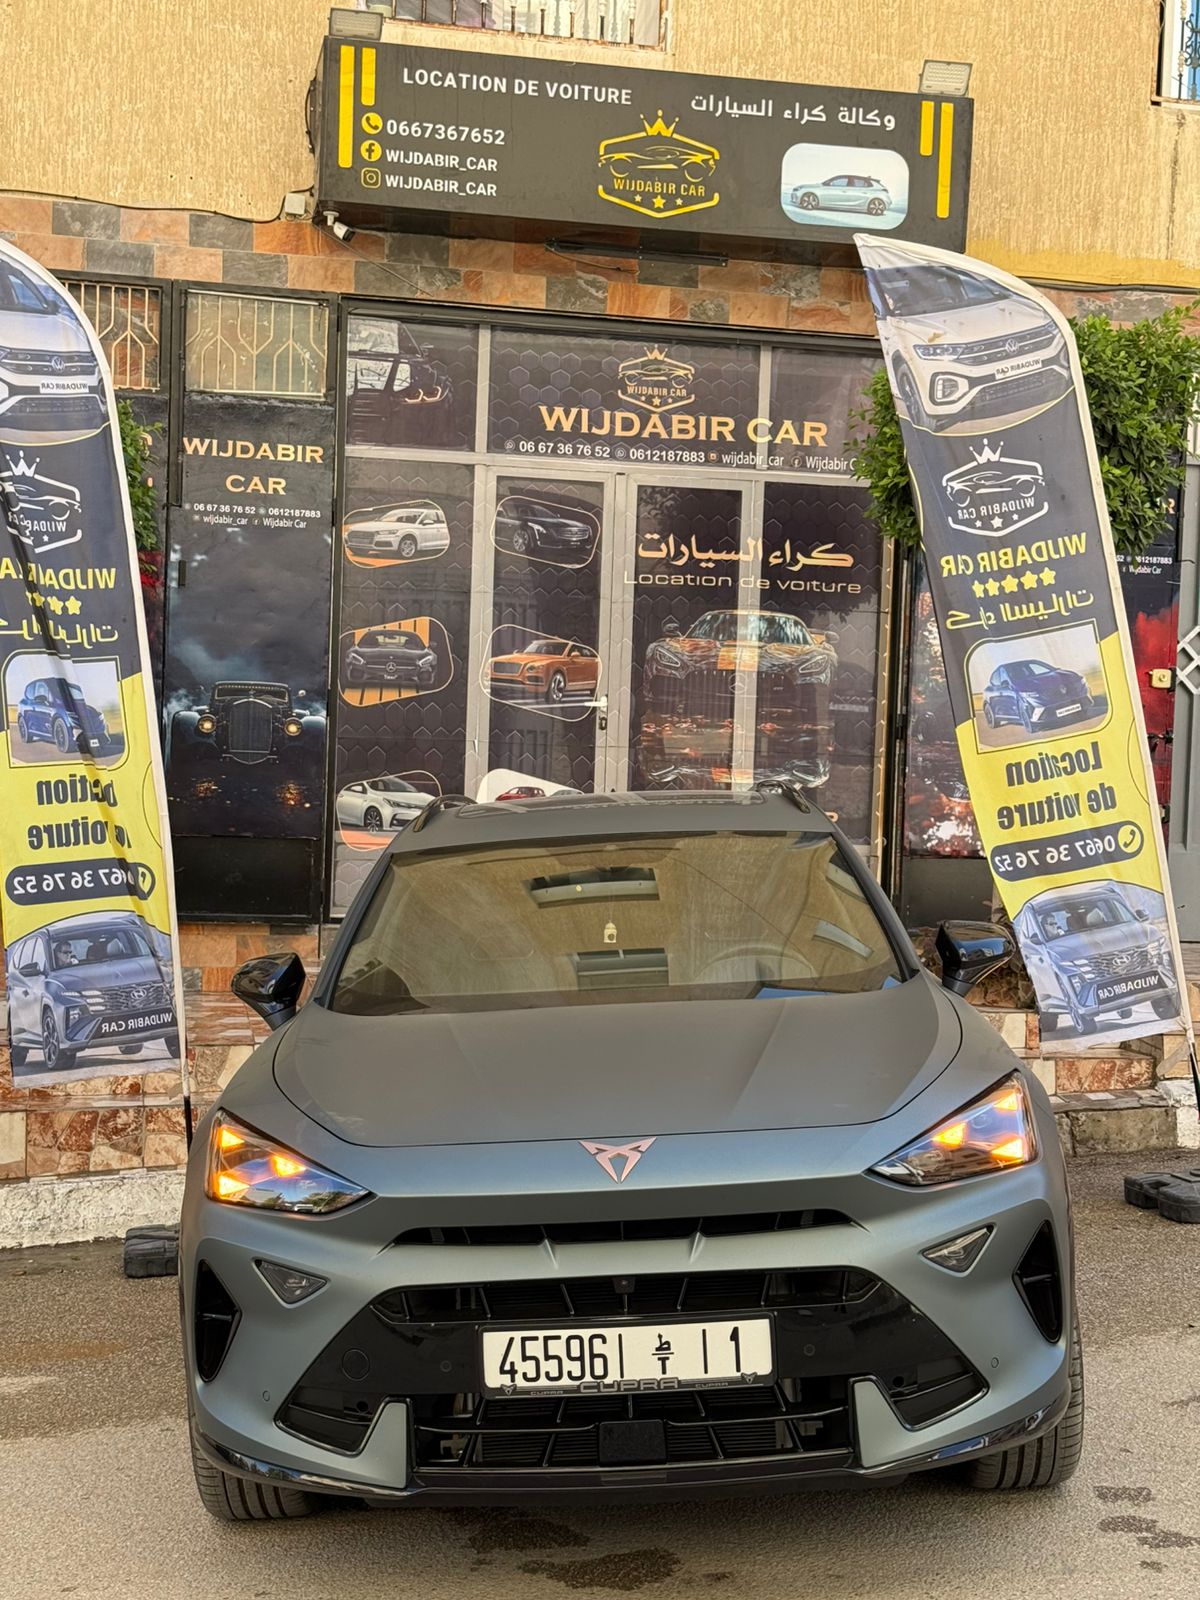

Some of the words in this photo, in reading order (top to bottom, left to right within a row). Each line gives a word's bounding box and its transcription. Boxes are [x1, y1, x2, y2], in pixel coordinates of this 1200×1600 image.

[403, 67, 507, 94] LOCATION
[514, 78, 539, 97] DE
[545, 82, 633, 105] VOITURE
[691, 93, 773, 118] السيارات
[783, 104, 827, 126] كراء
[838, 107, 896, 131] وكالة
[386, 118, 506, 146] 0667367652
[385, 149, 498, 172] WIJDABIR_CAR
[385, 174, 498, 197] WIJDABIR_CAR
[613, 178, 676, 195] WIJDABIR
[680, 183, 706, 197] CAR
[627, 385, 668, 396] WIJDABIR
[670, 388, 687, 397] CAR
[538, 404, 736, 443] WIJDABIR
[746, 417, 828, 447] CAR
[182, 437, 324, 464] WIJDABIR
[519, 440, 536, 453] 06
[538, 441, 555, 454] 67
[556, 442, 574, 455] 36
[576, 443, 592, 456] 76
[594, 444, 610, 458] 52
[629, 448, 705, 463] 0612187883
[721, 450, 784, 468] wijdabir_car
[805, 455, 848, 471] Wijdabir
[225, 474, 287, 496] CAR
[193, 503, 205, 511] 06
[206, 504, 218, 512] 67
[245, 506, 256, 514] 52
[294, 519, 307, 528] Car
[637, 532, 763, 566] السيارات
[768, 538, 855, 572] كراء
[623, 569, 732, 588] Location
[740, 574, 770, 590] de
[777, 578, 862, 595] voiture
[499, 1333, 609, 1383] 45596
[729, 1326, 742, 1373] 1
[579, 1377, 680, 1393] CUPRA
